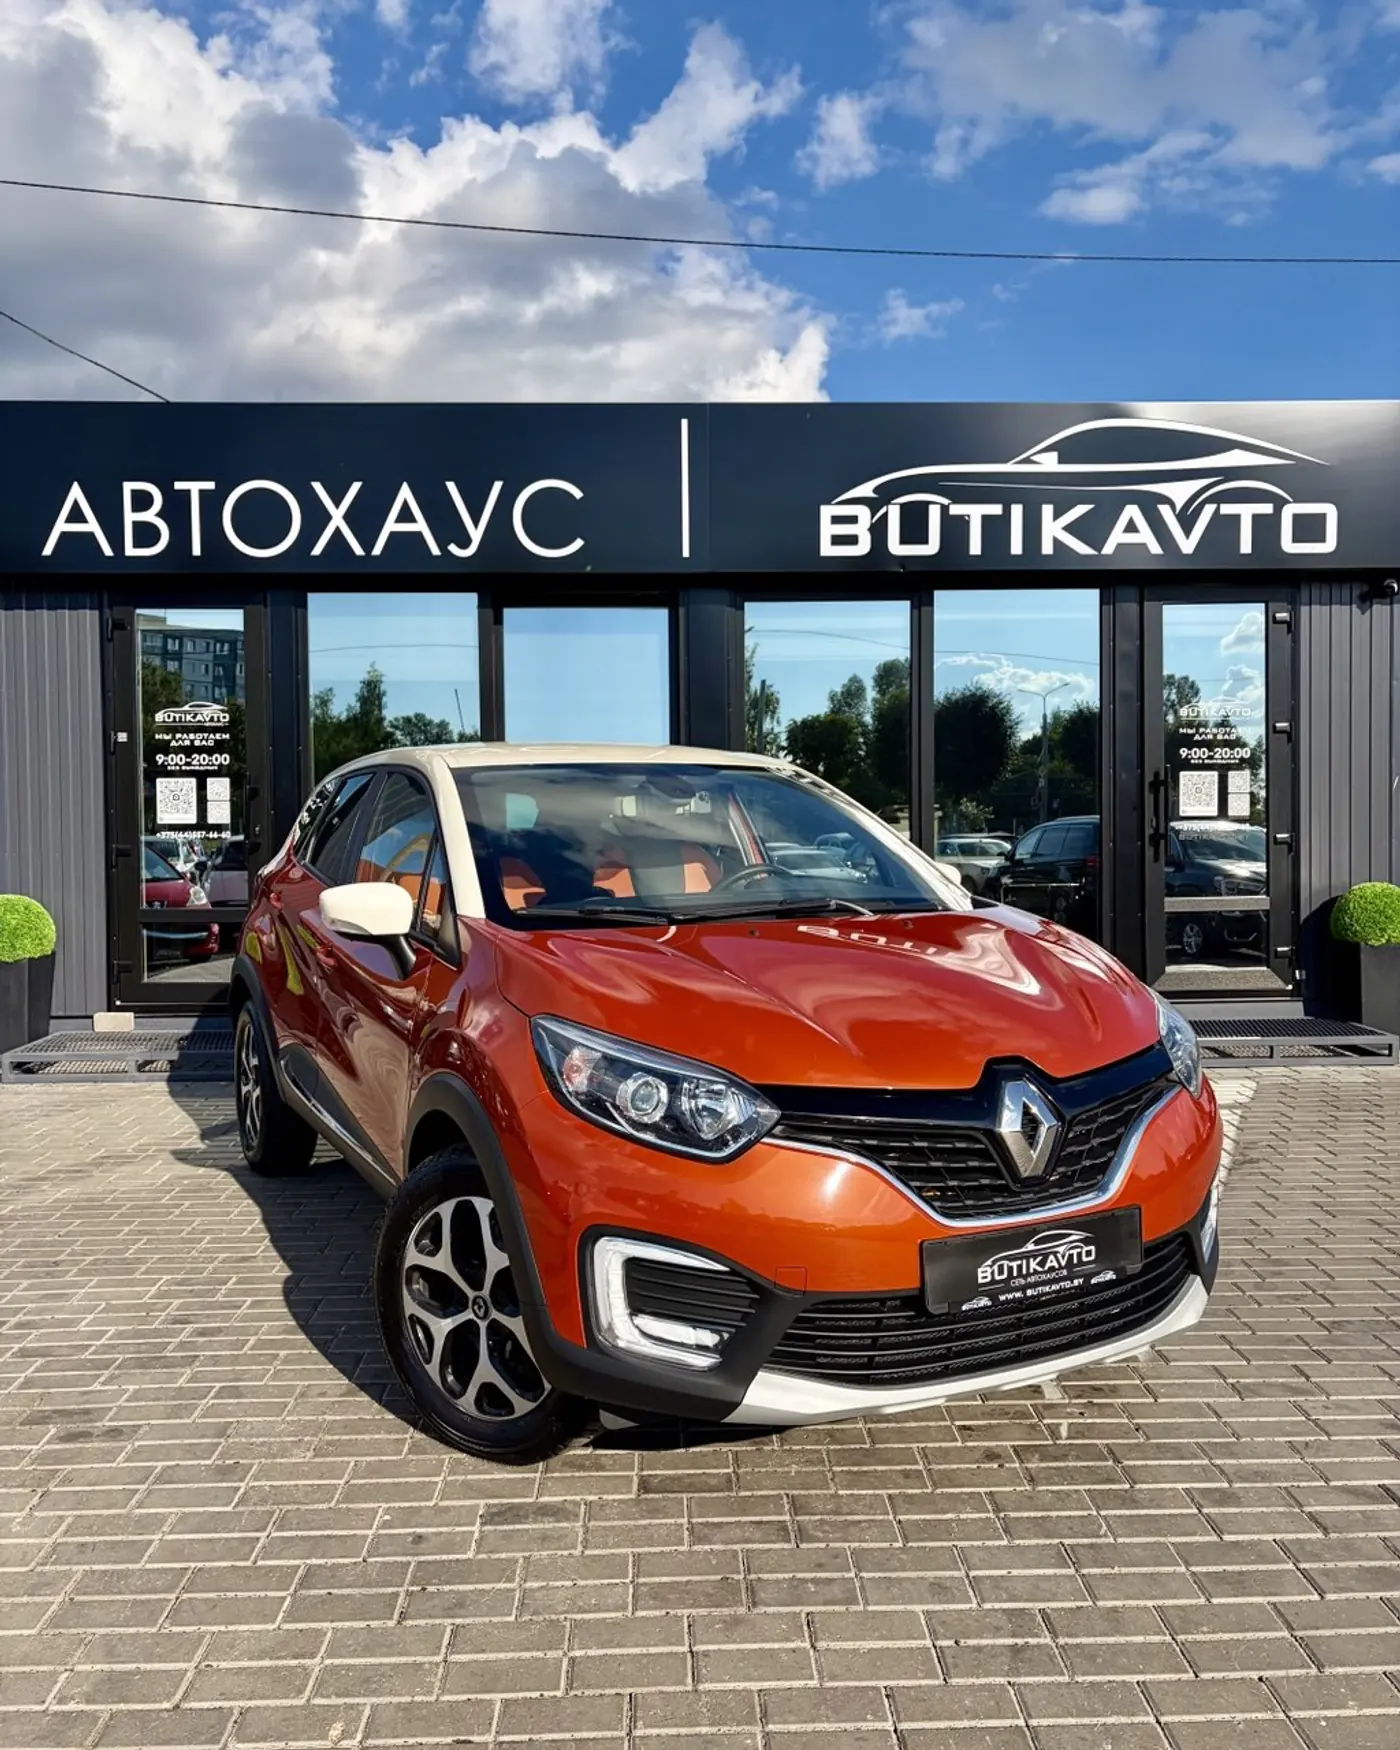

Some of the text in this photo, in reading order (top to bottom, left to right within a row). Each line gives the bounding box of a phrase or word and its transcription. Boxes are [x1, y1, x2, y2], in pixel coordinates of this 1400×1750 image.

[42, 479, 585, 558] АВТОХАУС
[818, 502, 1339, 557] BUTIKAVTO
[154, 712, 230, 723] BUTIKAVTO
[154, 732, 230, 740] МЫ РАБОТАЕМ
[169, 739, 191, 747] ДЛЯ
[155, 753, 230, 765] 9:00-20:00
[1179, 747, 1251, 759] 9:00-20:00
[977, 1245, 1096, 1284] BUTIKAVTO
[998, 1278, 1085, 1302] WWW. BUTIKAVTO.BY
